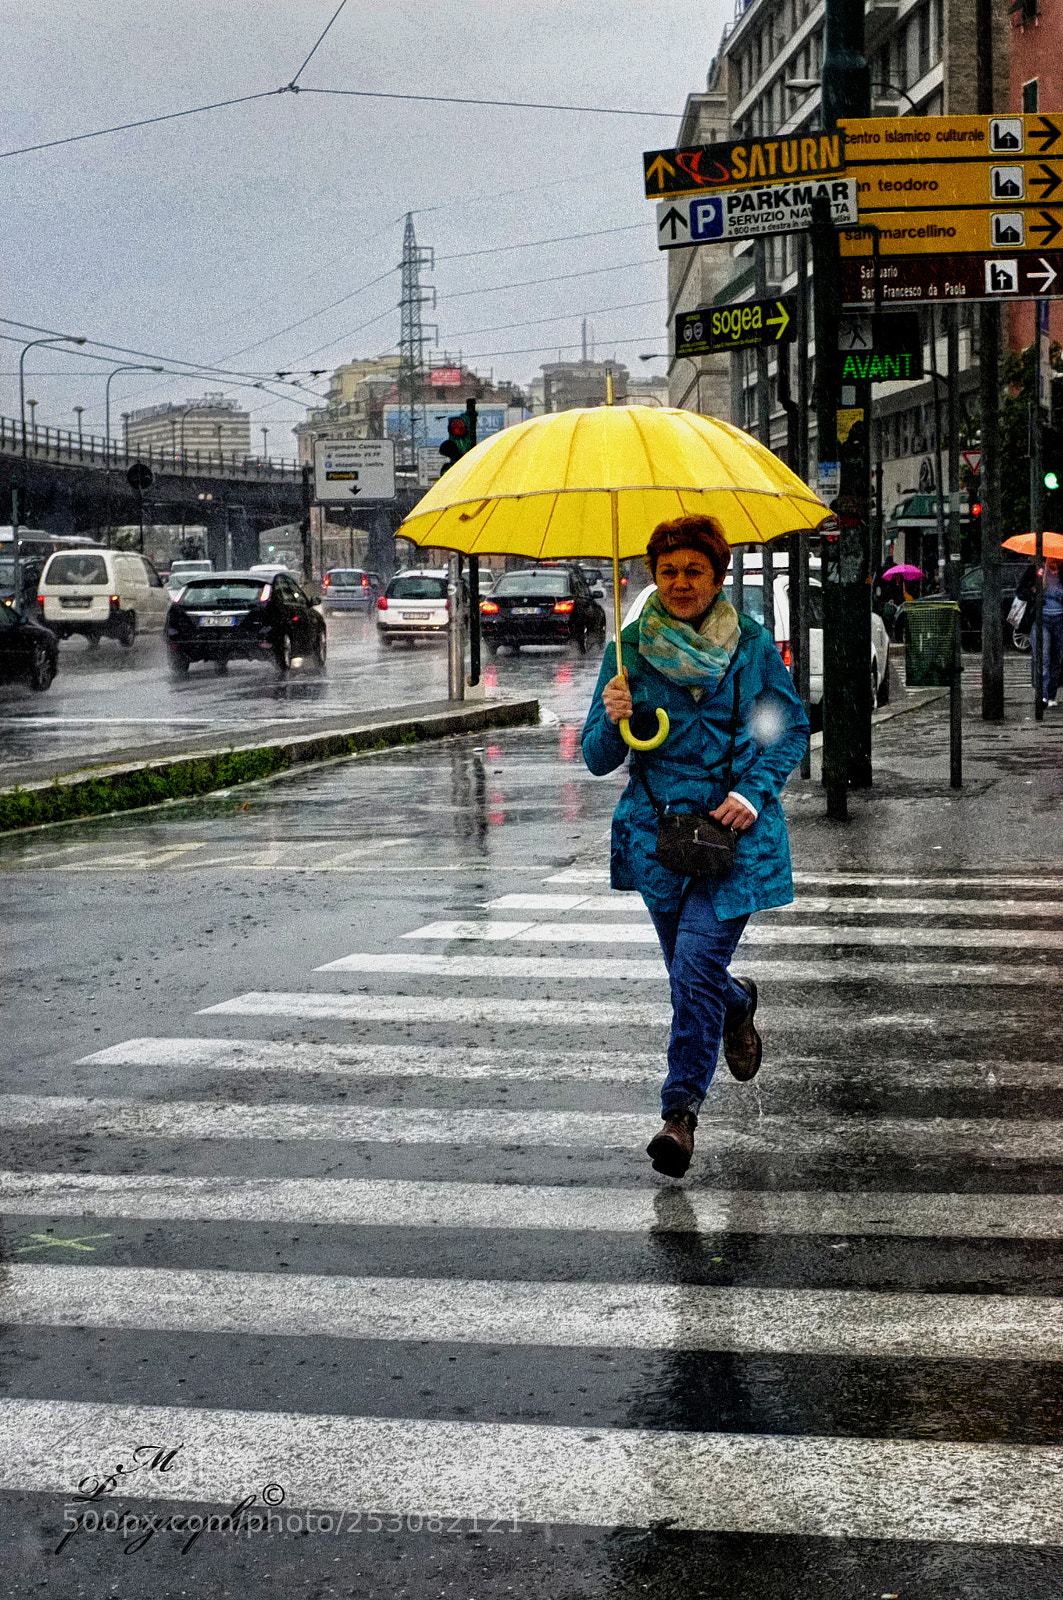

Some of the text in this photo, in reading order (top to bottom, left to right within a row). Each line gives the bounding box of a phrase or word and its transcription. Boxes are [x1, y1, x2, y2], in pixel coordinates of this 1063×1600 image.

[844, 128, 985, 144] centro islamico culturale
[731, 134, 841, 180] SATURN
[857, 178, 939, 192] an teodoro
[727, 182, 849, 215] PARKMAR
[697, 205, 716, 234] P
[728, 210, 785, 227] SERVIZIO
[767, 222, 791, 231] destra
[879, 224, 957, 240] marcellino
[883, 284, 922, 298] Francesco
[928, 283, 938, 296] da
[945, 282, 966, 296] Paola
[712, 305, 763, 340] sogea
[842, 353, 913, 379] AVANT
